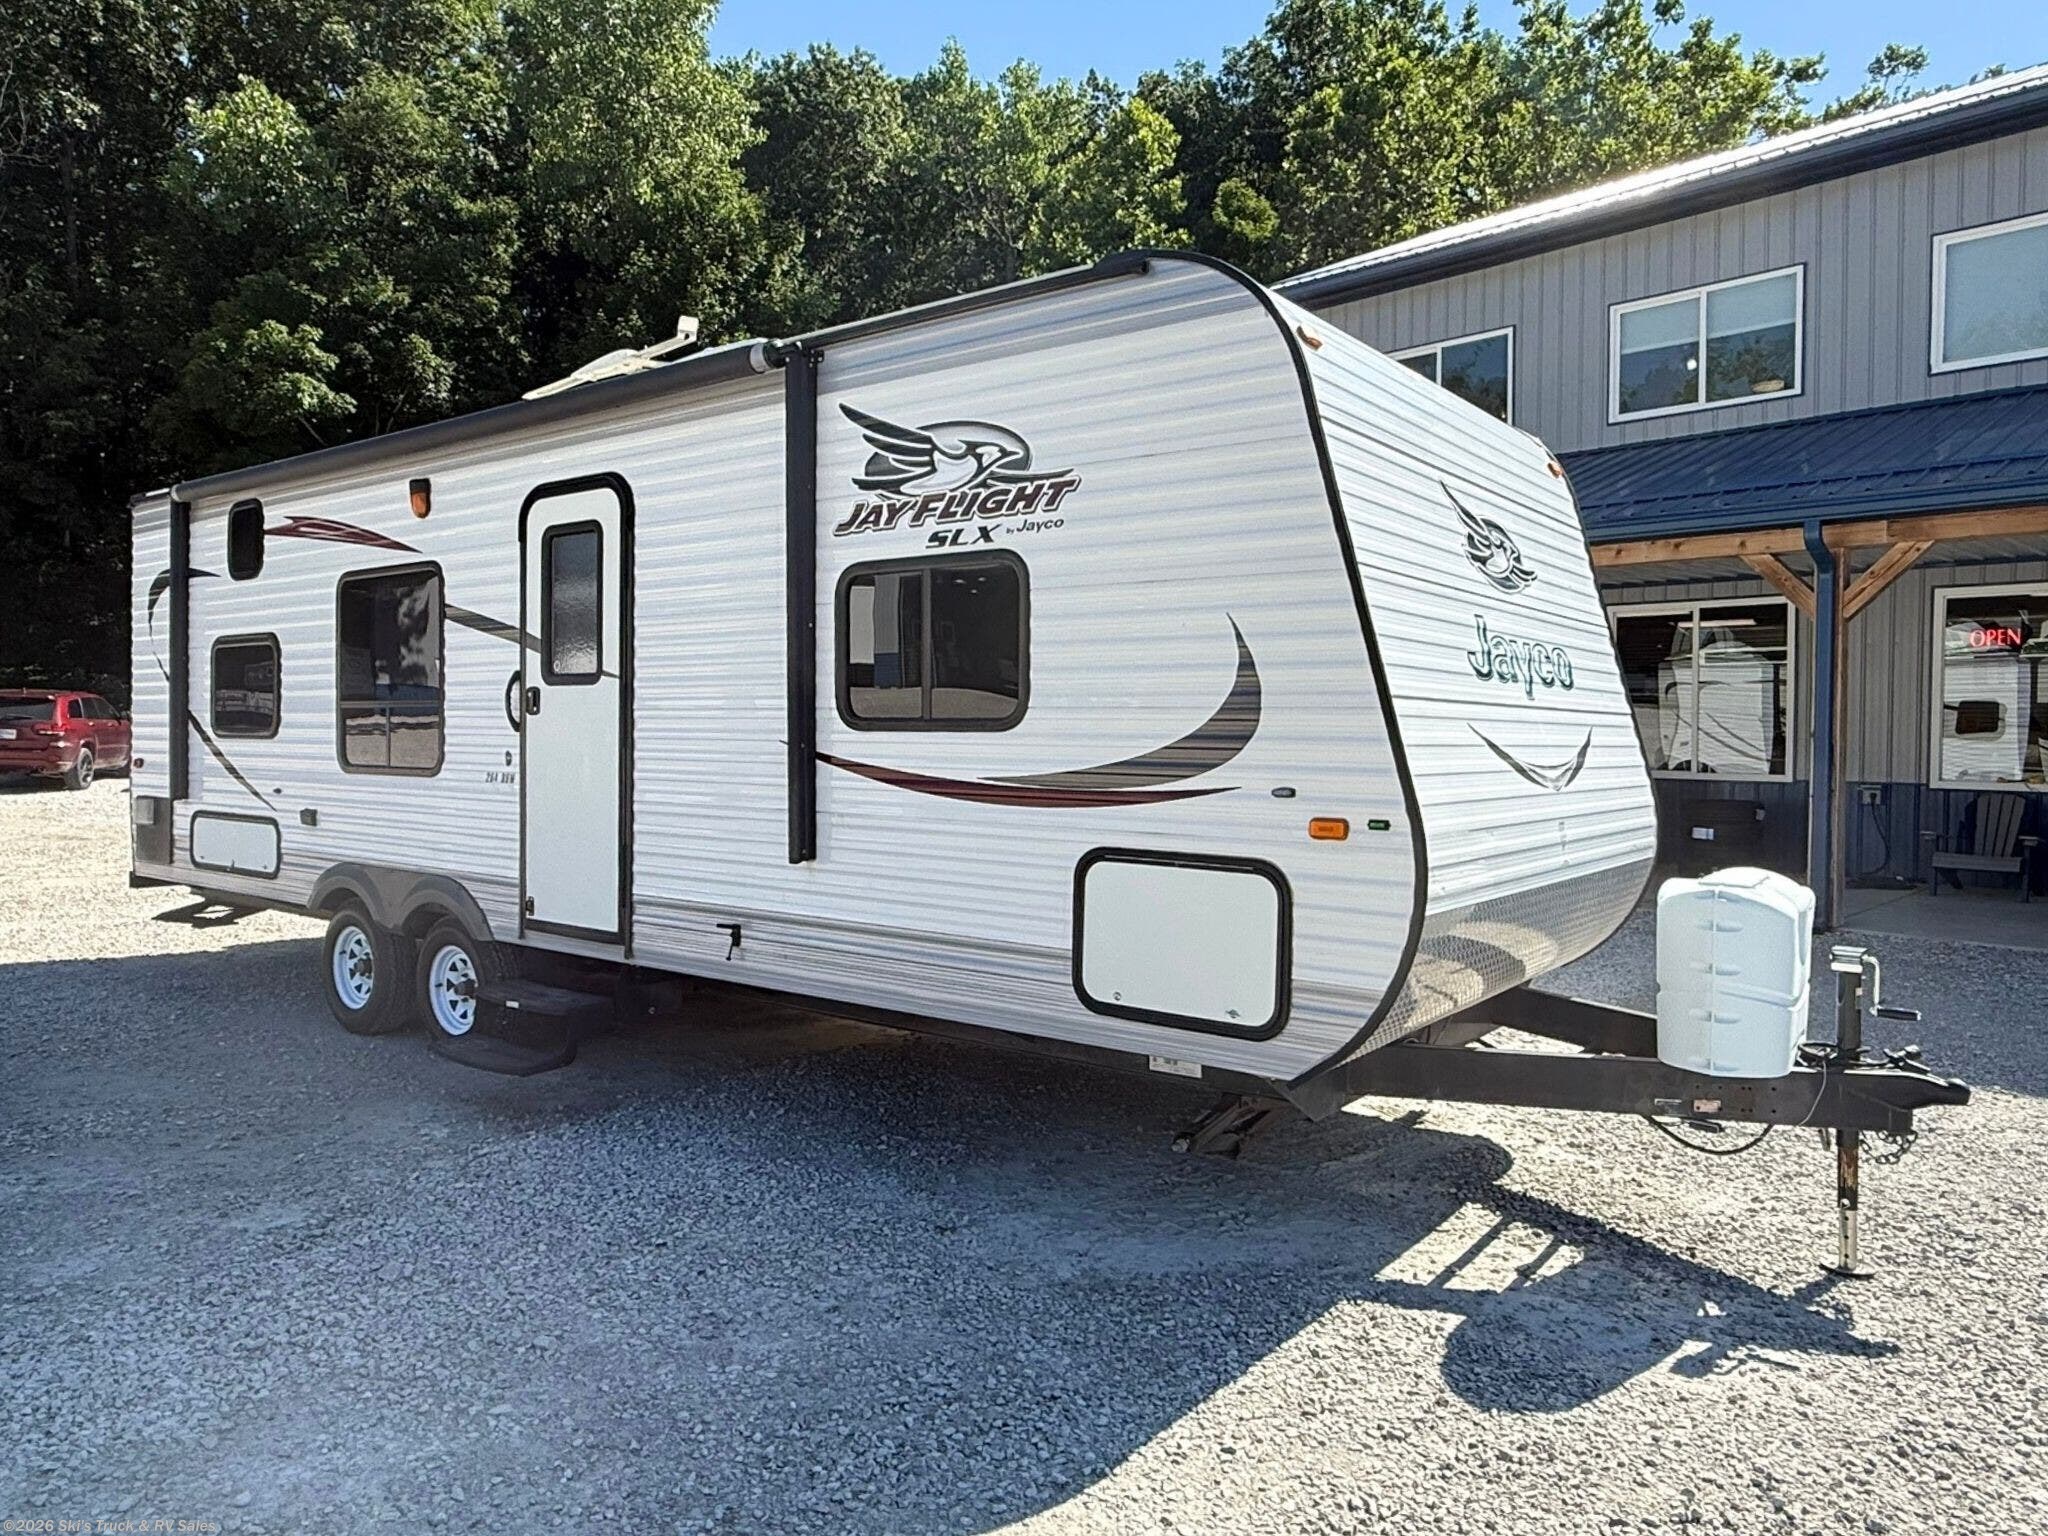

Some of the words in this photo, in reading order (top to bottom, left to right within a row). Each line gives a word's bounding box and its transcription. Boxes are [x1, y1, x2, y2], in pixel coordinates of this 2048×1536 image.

[925, 524, 1001, 549] SLX
[1016, 518, 1065, 536] Jayco
[1970, 628, 2022, 648] OPEN
[1467, 613, 1575, 701] Jayco
